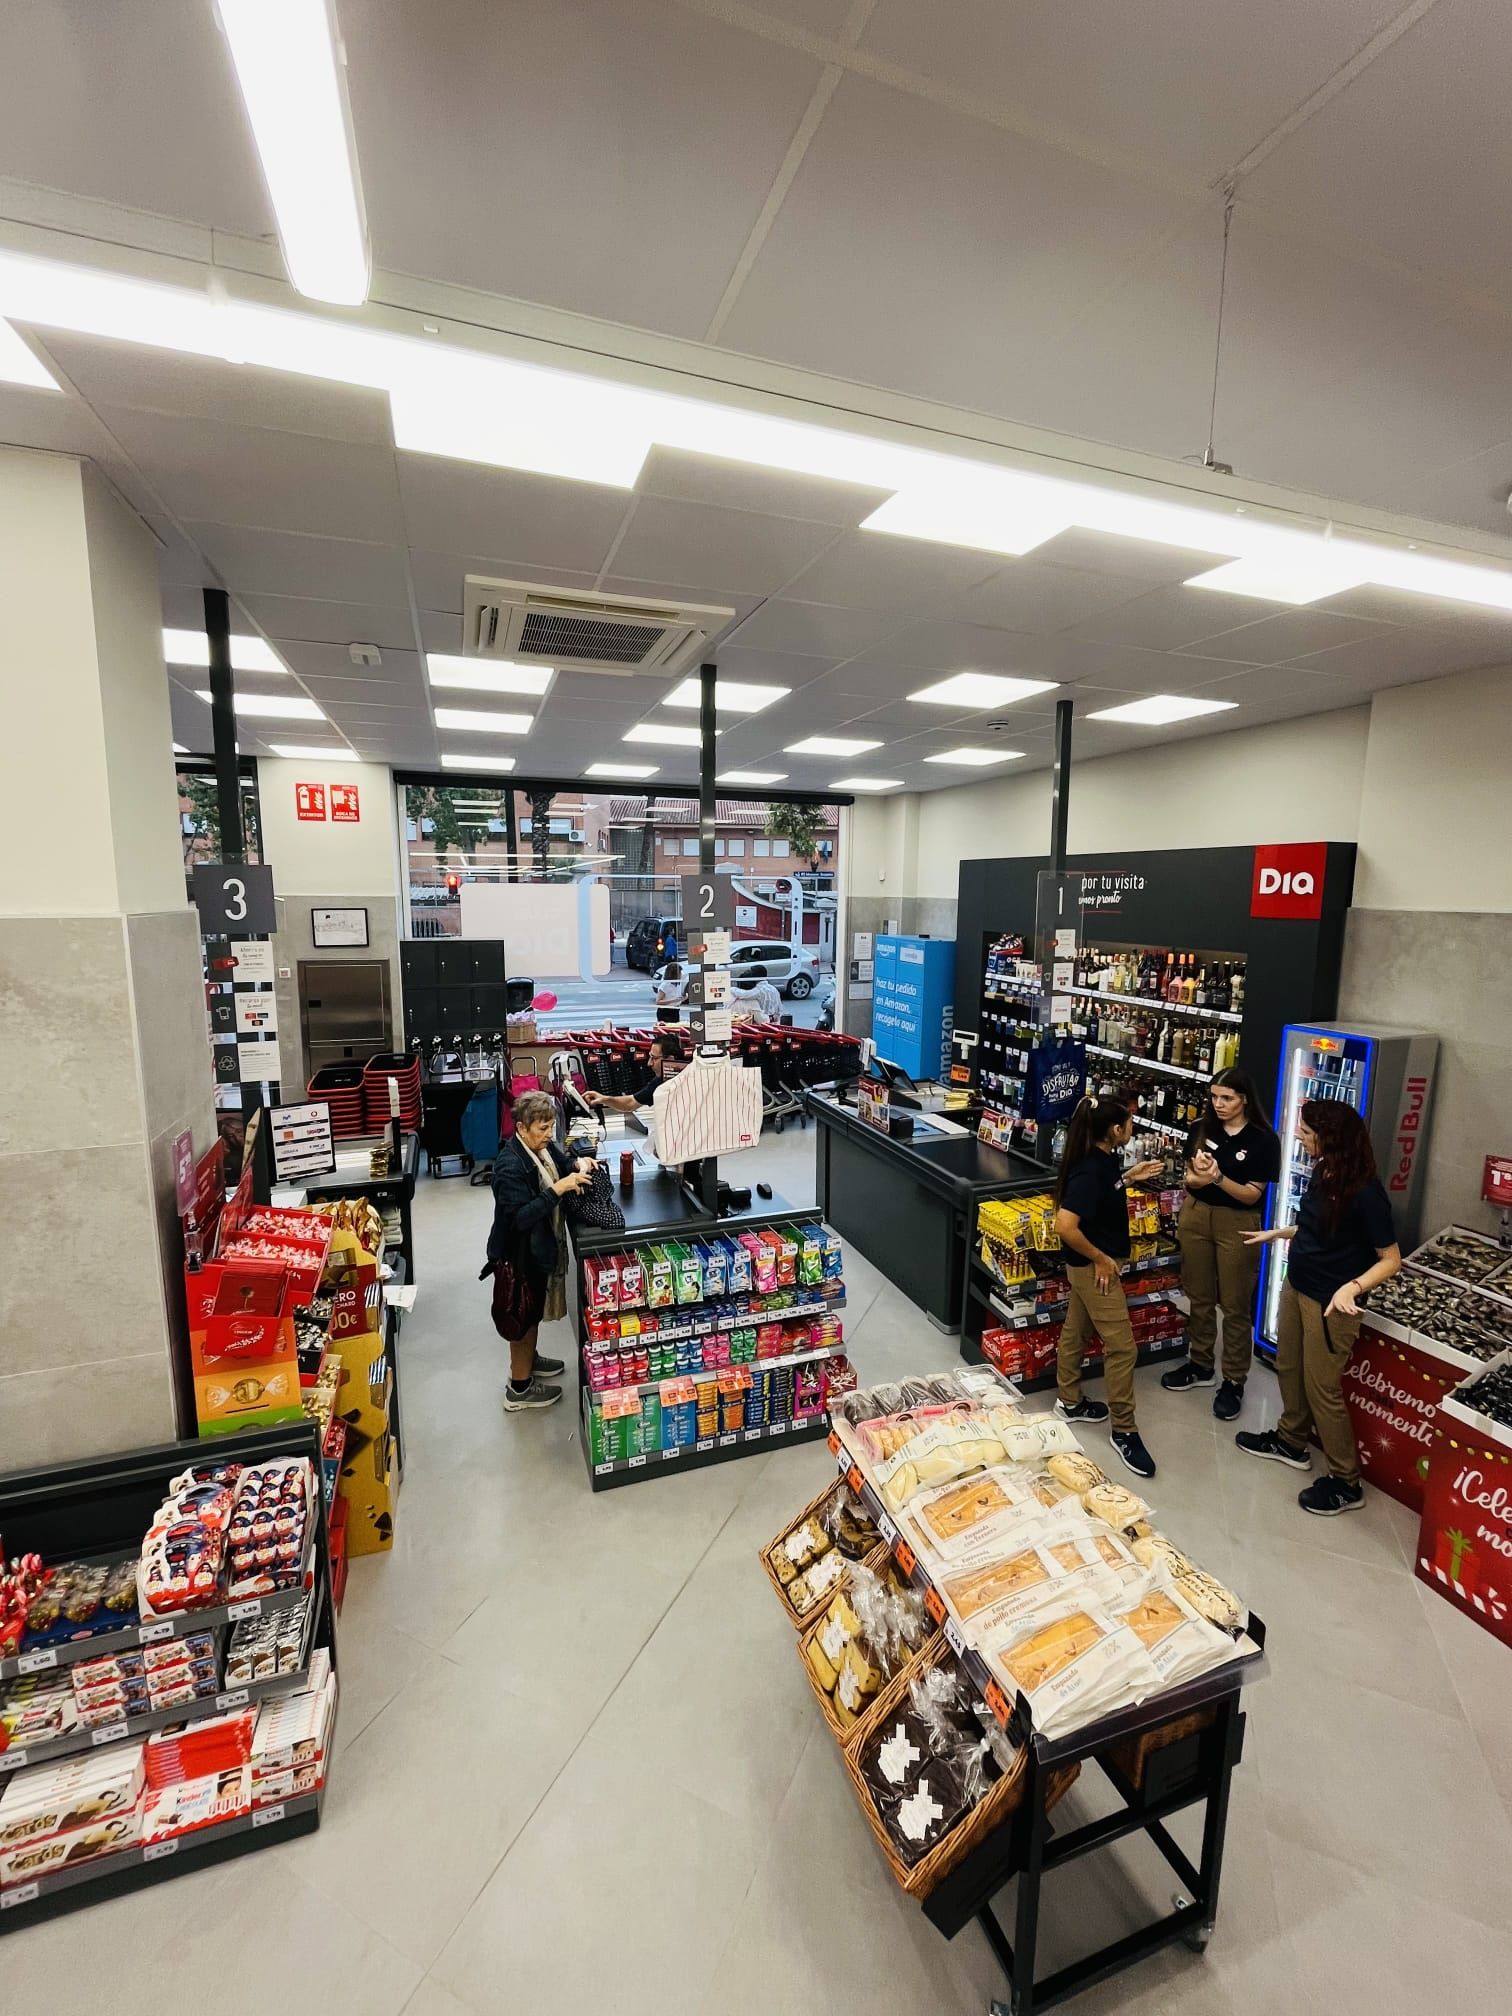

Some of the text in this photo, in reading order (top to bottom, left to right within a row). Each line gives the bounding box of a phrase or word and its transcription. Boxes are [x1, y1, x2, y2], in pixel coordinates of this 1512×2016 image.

[1081, 873, 1145, 892] por tu visita
[1259, 868, 1314, 895] Dia
[223, 878, 247, 921] 3
[699, 884, 715, 918] 2
[1058, 886, 1064, 915] 1
[1096, 890, 1122, 909] pronto
[876, 976, 917, 996] haz tu pedido
[876, 996, 884, 1006] en
[938, 1004, 954, 1087] amazon
[1042, 1072, 1080, 1097] DISFRUTAR
[1389, 1077, 1427, 1191] Red Bull
